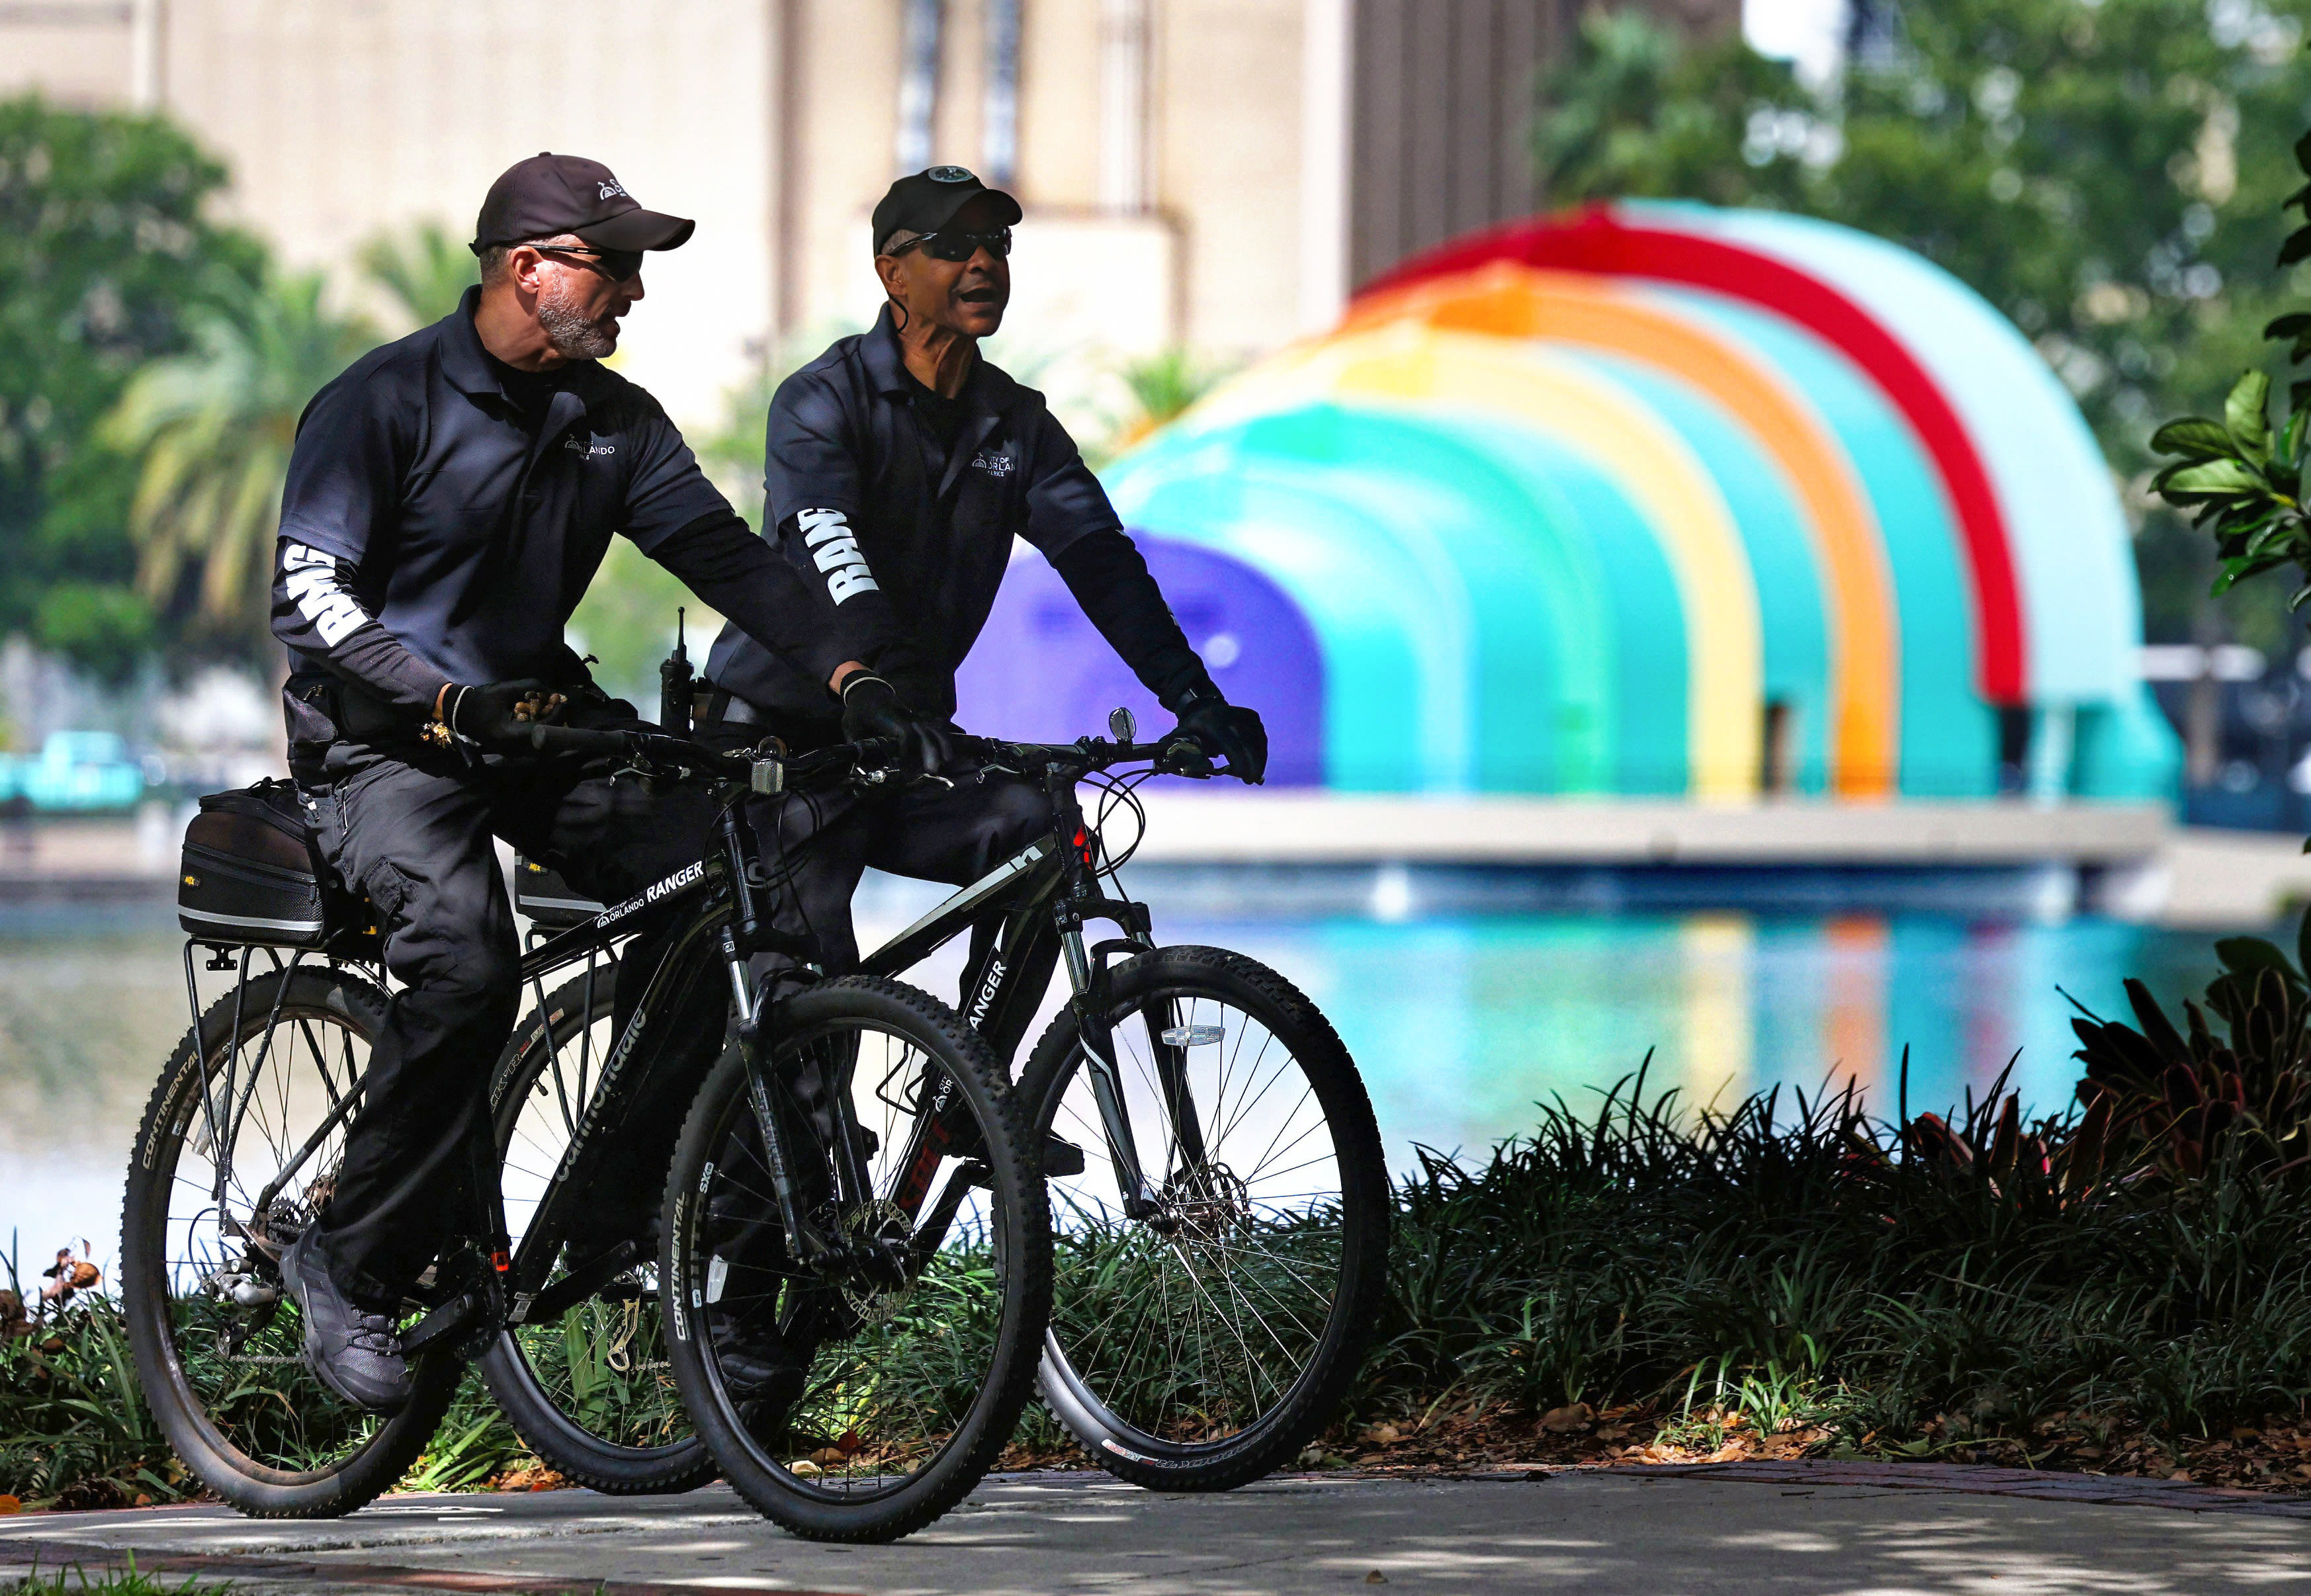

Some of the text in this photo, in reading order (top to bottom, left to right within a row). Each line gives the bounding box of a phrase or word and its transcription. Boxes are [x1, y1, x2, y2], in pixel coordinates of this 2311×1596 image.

[609, 861, 703, 921] ORLANDO RANGER
[969, 960, 1008, 1032] ANGER
[671, 1191, 686, 1341] CONTINENTAL
